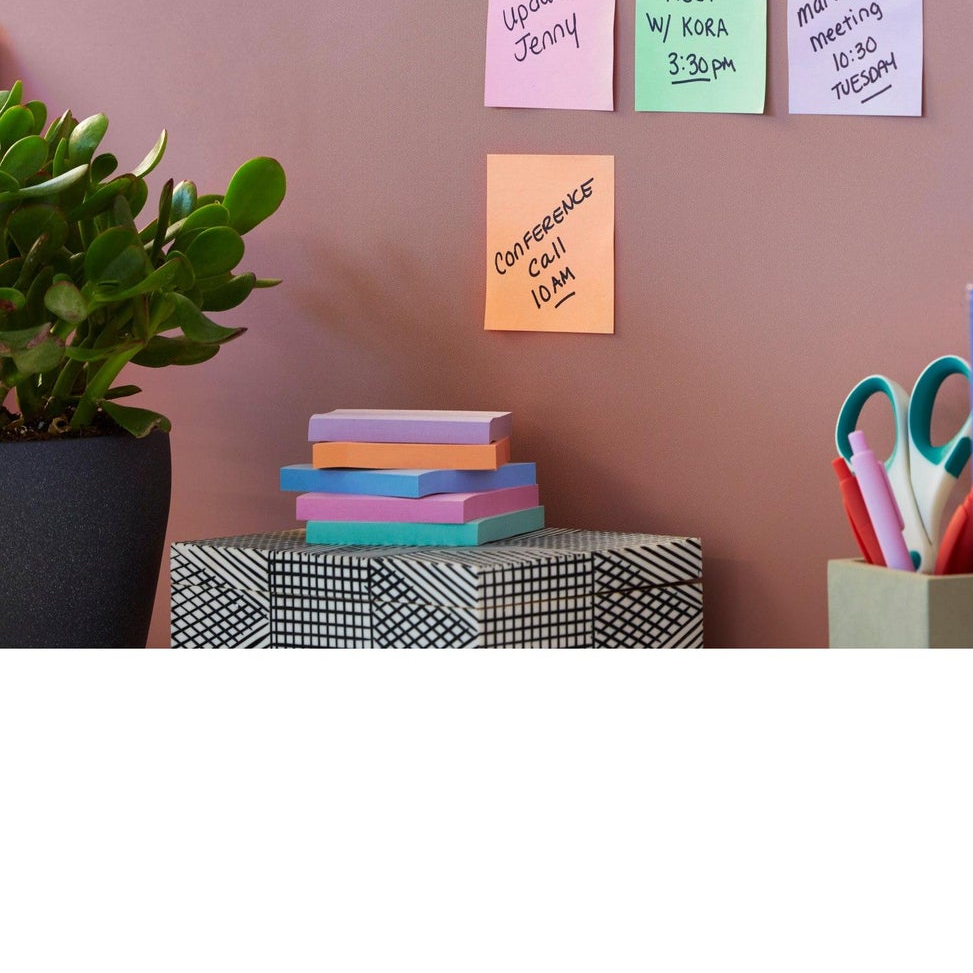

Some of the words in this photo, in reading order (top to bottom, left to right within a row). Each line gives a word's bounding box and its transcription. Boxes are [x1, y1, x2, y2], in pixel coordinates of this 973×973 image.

[513, 12, 580, 62] Jenny
[682, 16, 729, 38] KORA
[832, 35, 878, 72] 10:30
[831, 51, 898, 100] TUESDAY
